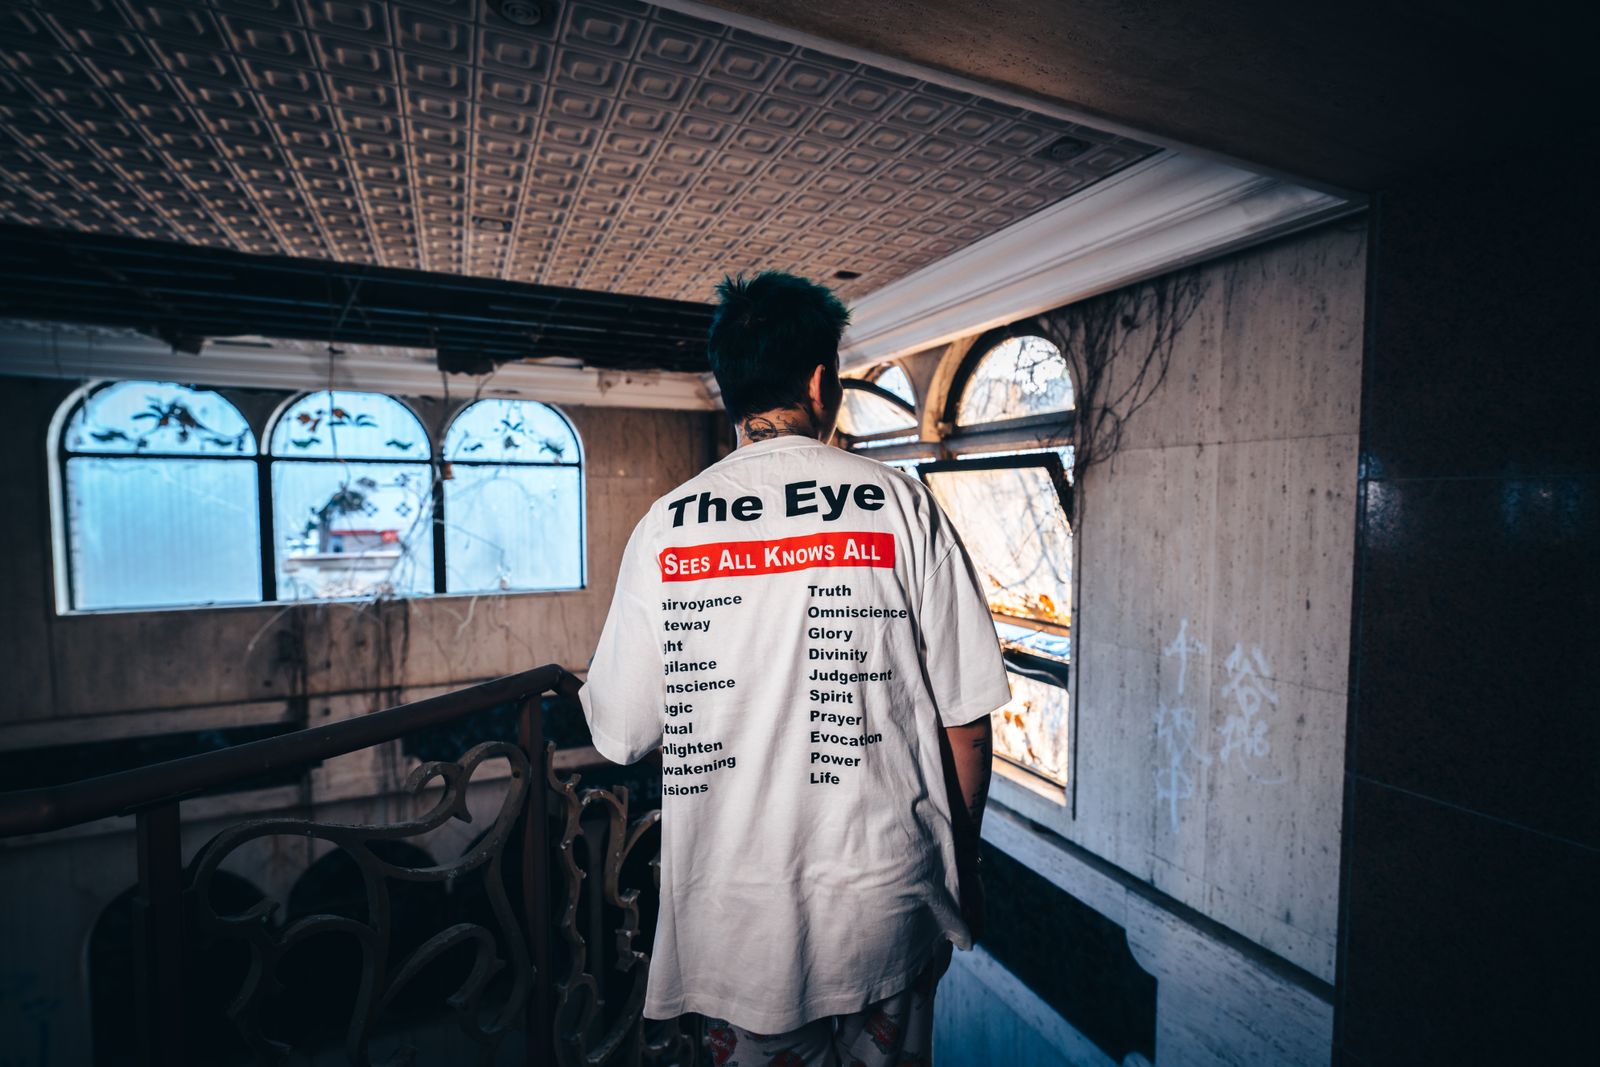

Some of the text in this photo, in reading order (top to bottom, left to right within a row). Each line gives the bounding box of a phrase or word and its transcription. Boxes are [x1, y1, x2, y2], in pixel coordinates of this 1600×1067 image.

[668, 479, 886, 528] The Eye
[808, 584, 852, 598] Truth
[808, 606, 908, 619] Omniscience
[808, 627, 853, 642] Glory
[809, 648, 868, 663] Divinity
[809, 669, 893, 685] Judgement
[809, 690, 854, 705] Spirit
[810, 711, 863, 727] Prayer
[662, 722, 693, 736] tual
[810, 731, 883, 747] Evocation
[811, 752, 861, 767] Power
[810, 772, 841, 785] Life
